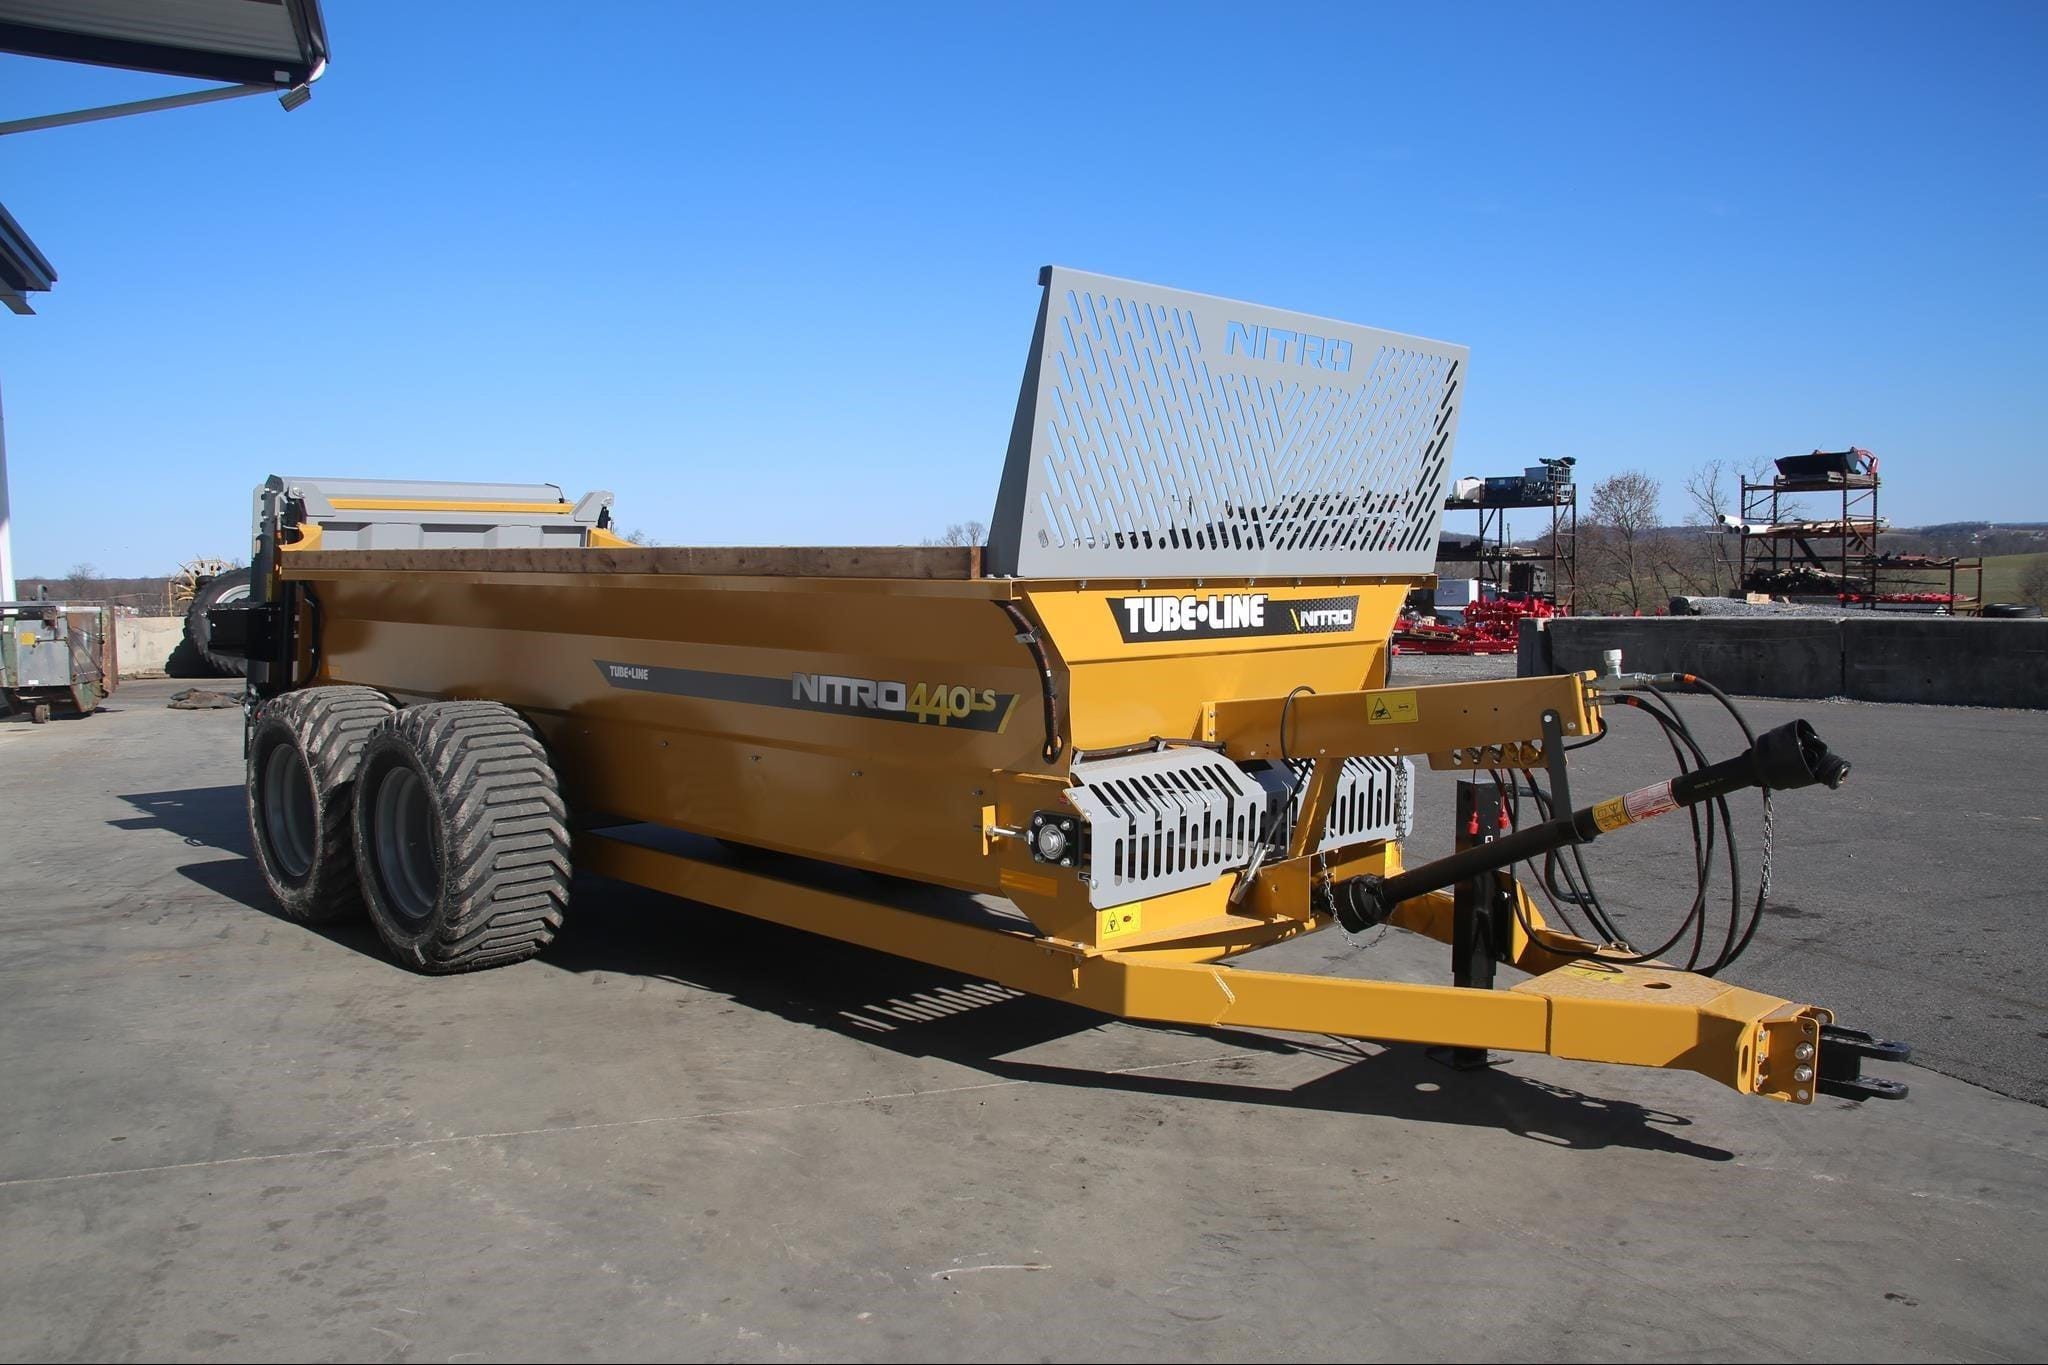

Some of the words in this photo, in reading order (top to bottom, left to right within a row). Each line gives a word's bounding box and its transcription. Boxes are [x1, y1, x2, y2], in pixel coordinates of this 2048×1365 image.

[1225, 320, 1353, 373] NITRO
[1300, 608, 1352, 628] NITRO
[792, 672, 906, 711] NITRO
